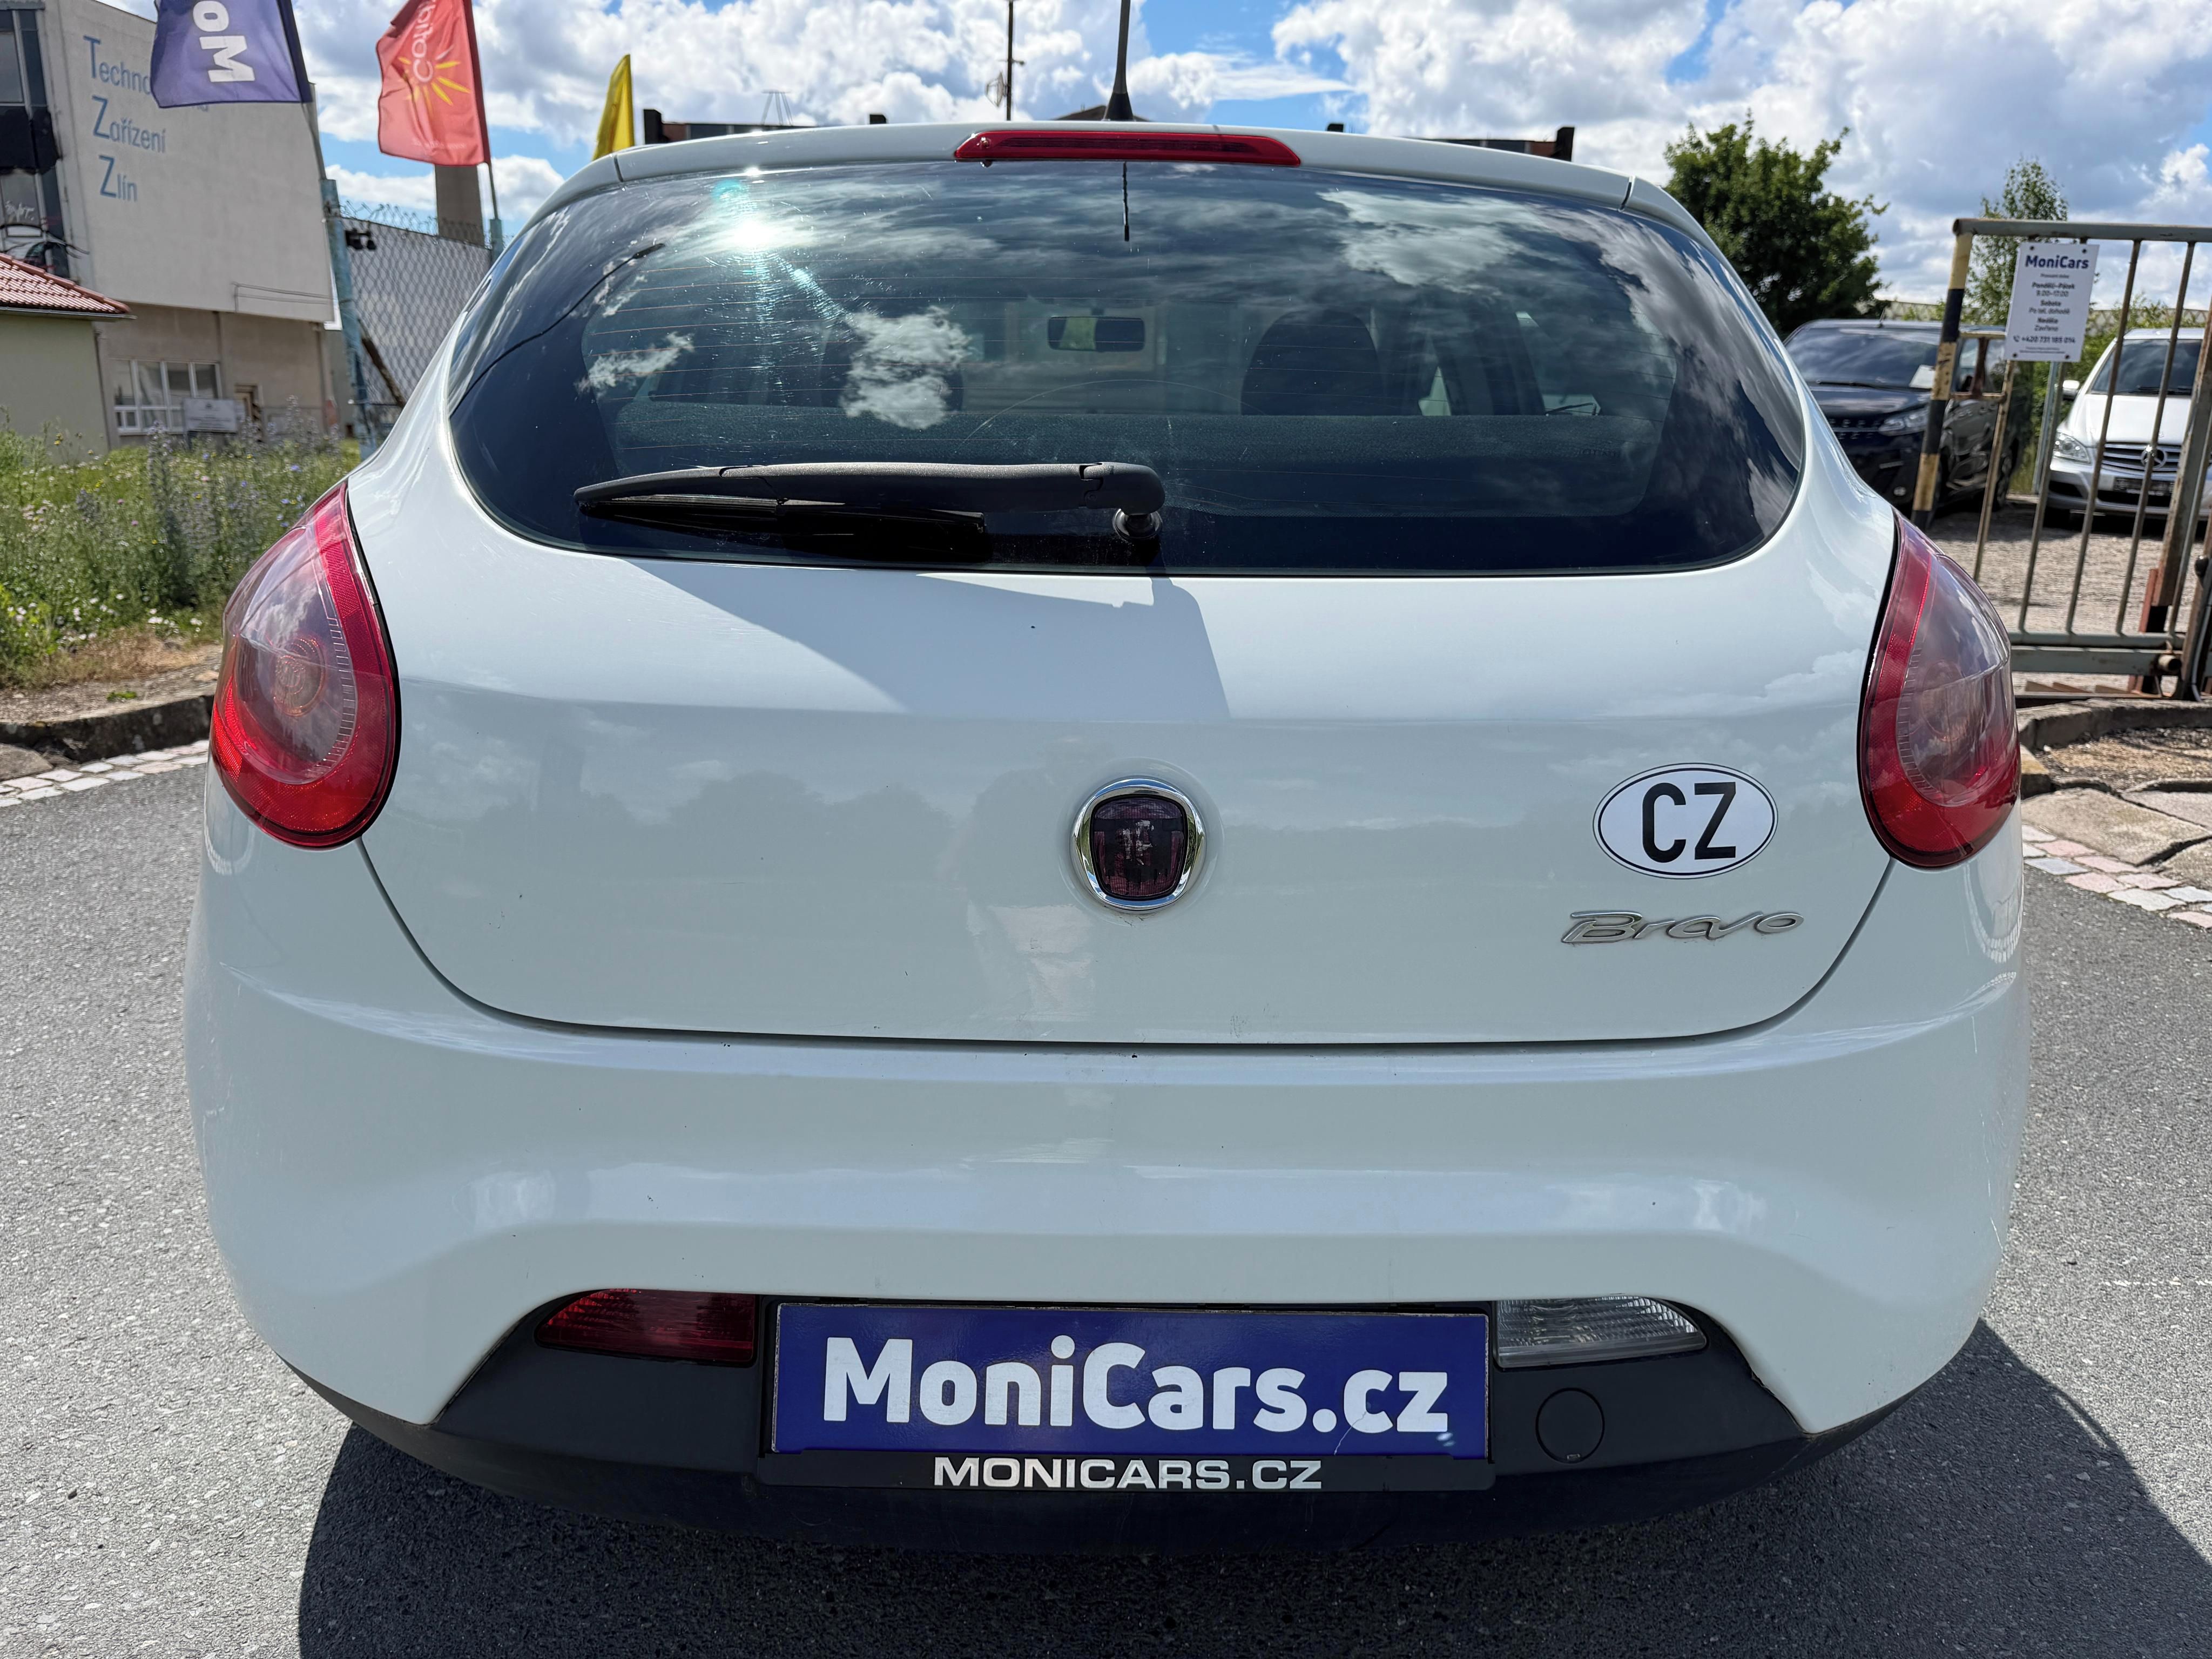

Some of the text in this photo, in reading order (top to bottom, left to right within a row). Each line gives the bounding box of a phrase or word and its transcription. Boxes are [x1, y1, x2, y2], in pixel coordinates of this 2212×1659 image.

[91, 94, 166, 153] Zařízení
[98, 154, 138, 202] Zlín
[2025, 255, 2089, 269] MoniCars
[1642, 781, 1737, 864] CZ
[1561, 910, 1805, 944] Bravo
[823, 1334, 1448, 1434] MoniCars.cz
[934, 1456, 1322, 1489] MONICARS.CZ
